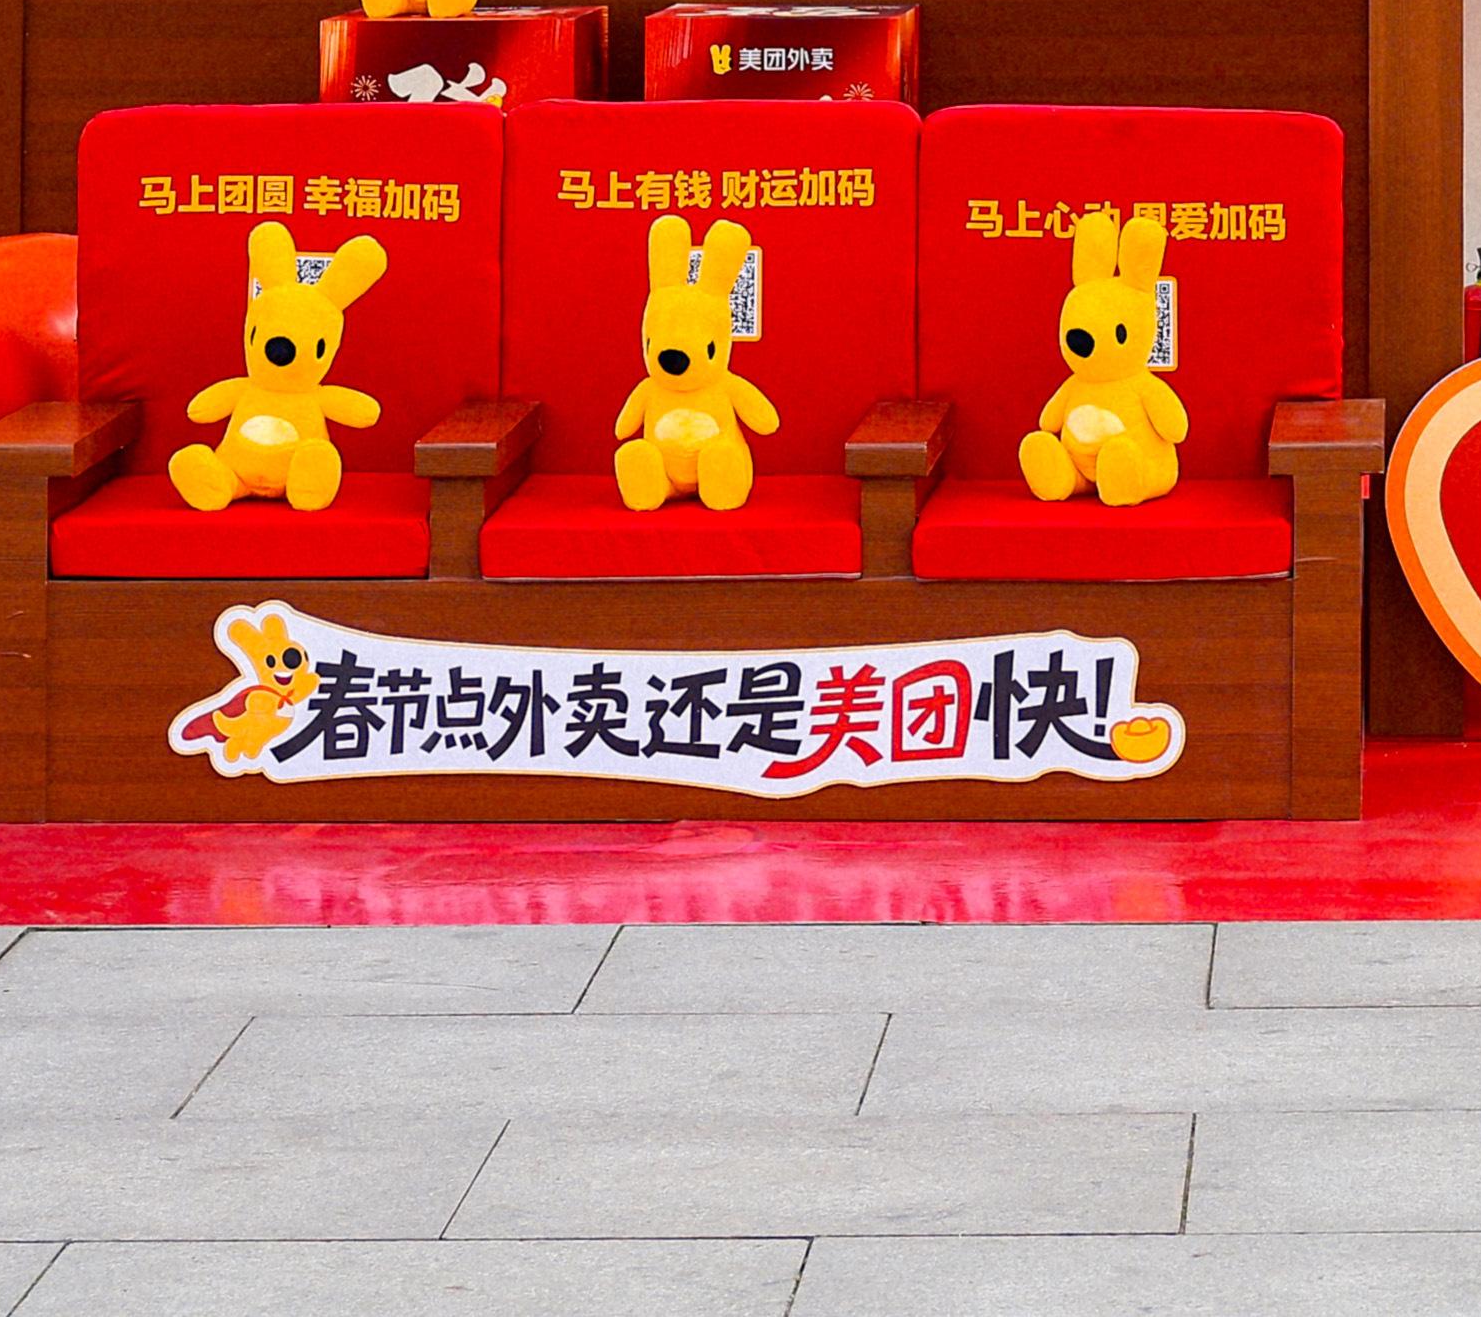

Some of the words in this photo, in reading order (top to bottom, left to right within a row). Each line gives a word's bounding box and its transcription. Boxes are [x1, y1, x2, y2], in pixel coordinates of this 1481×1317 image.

[738, 47, 835, 72] 美团外卖
[139, 173, 296, 217] 马上团圆
[303, 174, 461, 224] 幸福加码
[556, 168, 714, 212] 马上有钱
[721, 167, 876, 212] 财运加码
[269, 647, 1116, 779] 春节点外卖还是美团快!
